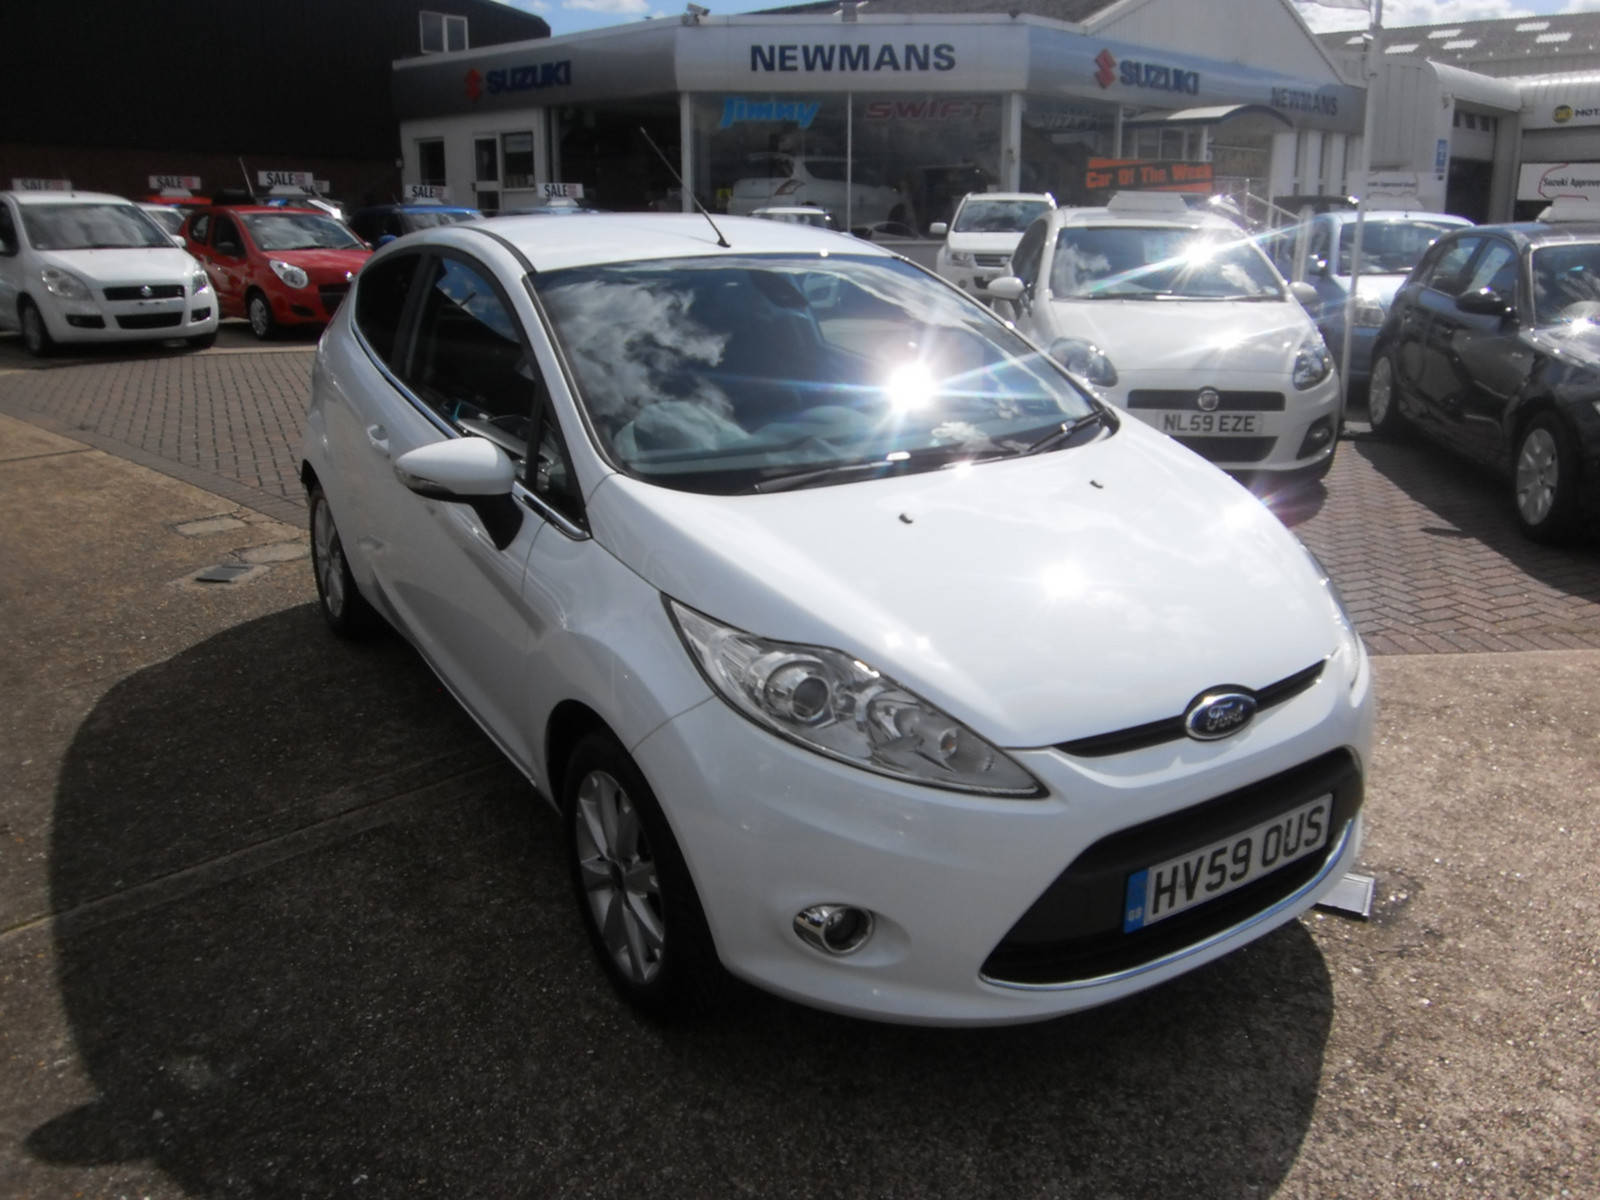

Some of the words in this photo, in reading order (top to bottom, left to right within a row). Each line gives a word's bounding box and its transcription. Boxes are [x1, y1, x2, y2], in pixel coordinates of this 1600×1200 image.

[751, 44, 956, 72] NEWMANS
[487, 60, 572, 94] SUZUKI
[1120, 60, 1200, 95] SUZUKI
[865, 100, 991, 120] SWIFT
[1271, 86, 1337, 116] NEWMANS
[156, 175, 182, 188] SALE
[266, 172, 295, 186] SALE
[1086, 171, 1112, 188] Car
[1141, 166, 1167, 183] The
[1544, 177, 1568, 187] Suzuki
[412, 185, 435, 198] SALE
[544, 184, 568, 198] SALE
[1164, 414, 1214, 432] NL59
[1218, 415, 1256, 432] EZE
[1152, 838, 1253, 915] HV59
